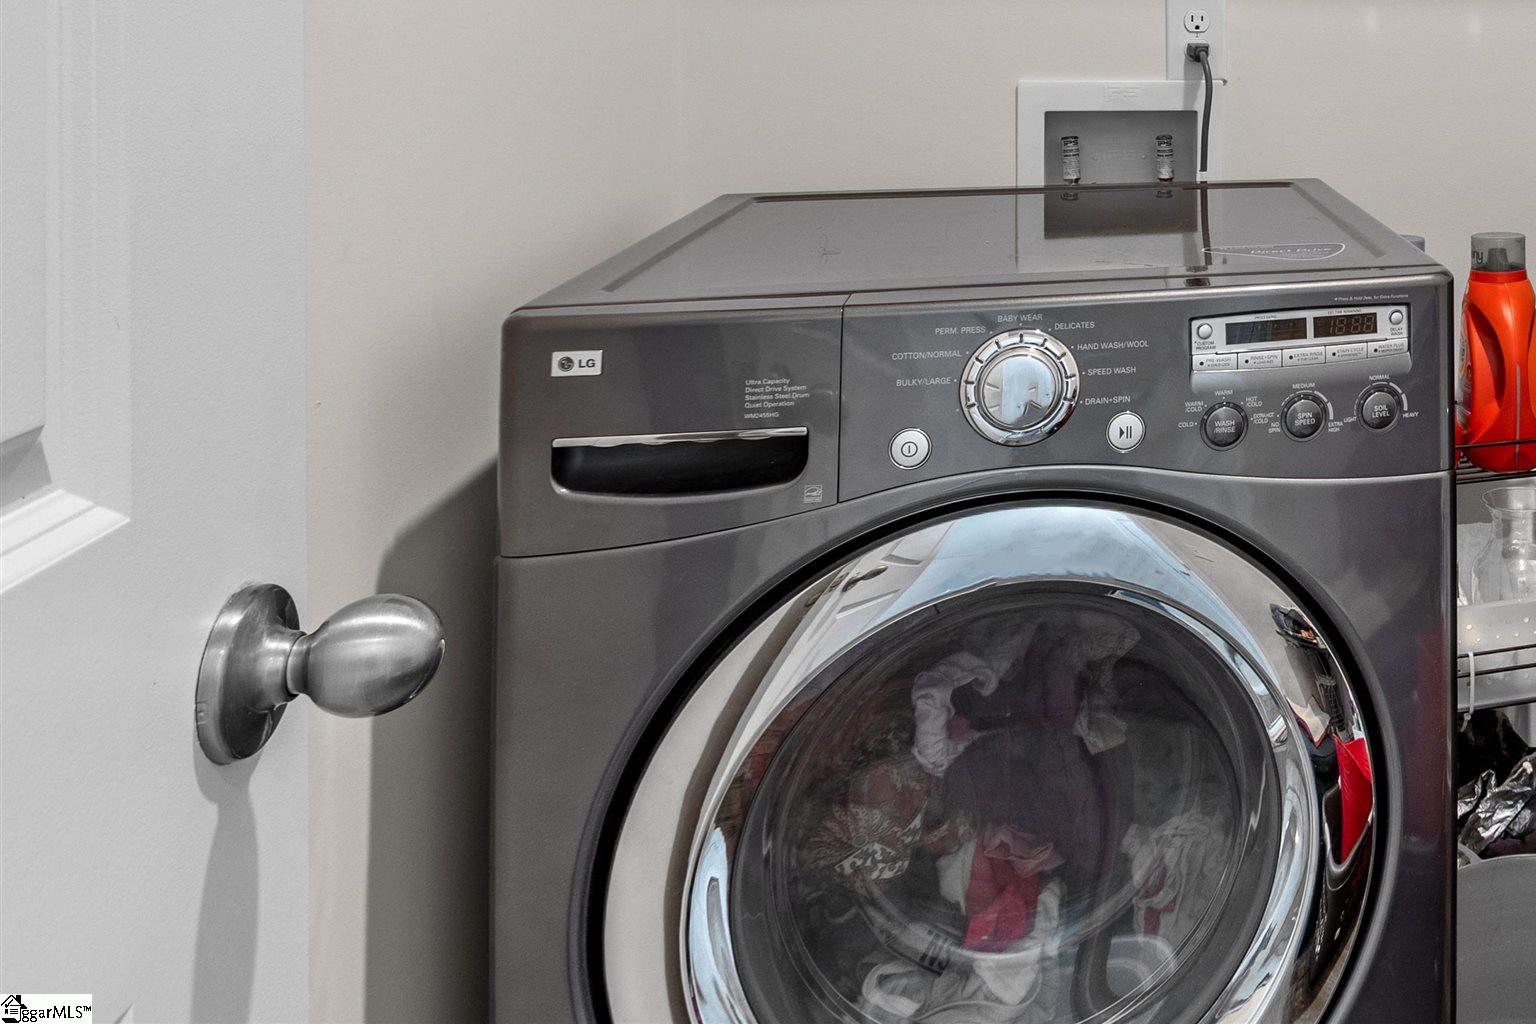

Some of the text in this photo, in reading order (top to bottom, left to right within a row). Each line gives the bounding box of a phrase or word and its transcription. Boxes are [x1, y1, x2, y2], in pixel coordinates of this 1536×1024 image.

[1019, 314, 1043, 322] WEAR
[960, 326, 986, 334] PRESS
[1054, 321, 1095, 330] DELICATES
[1077, 340, 1149, 350] HAND WASH/WOOL
[892, 350, 962, 361] COTTON/NORMAL
[578, 358, 596, 368] LG
[1087, 366, 1136, 376] SPEED WASH
[896, 377, 951, 387] BULKY/LARGE
[1085, 396, 1130, 405] DRAIN+SPIN
[1295, 418, 1316, 426] SPEED
